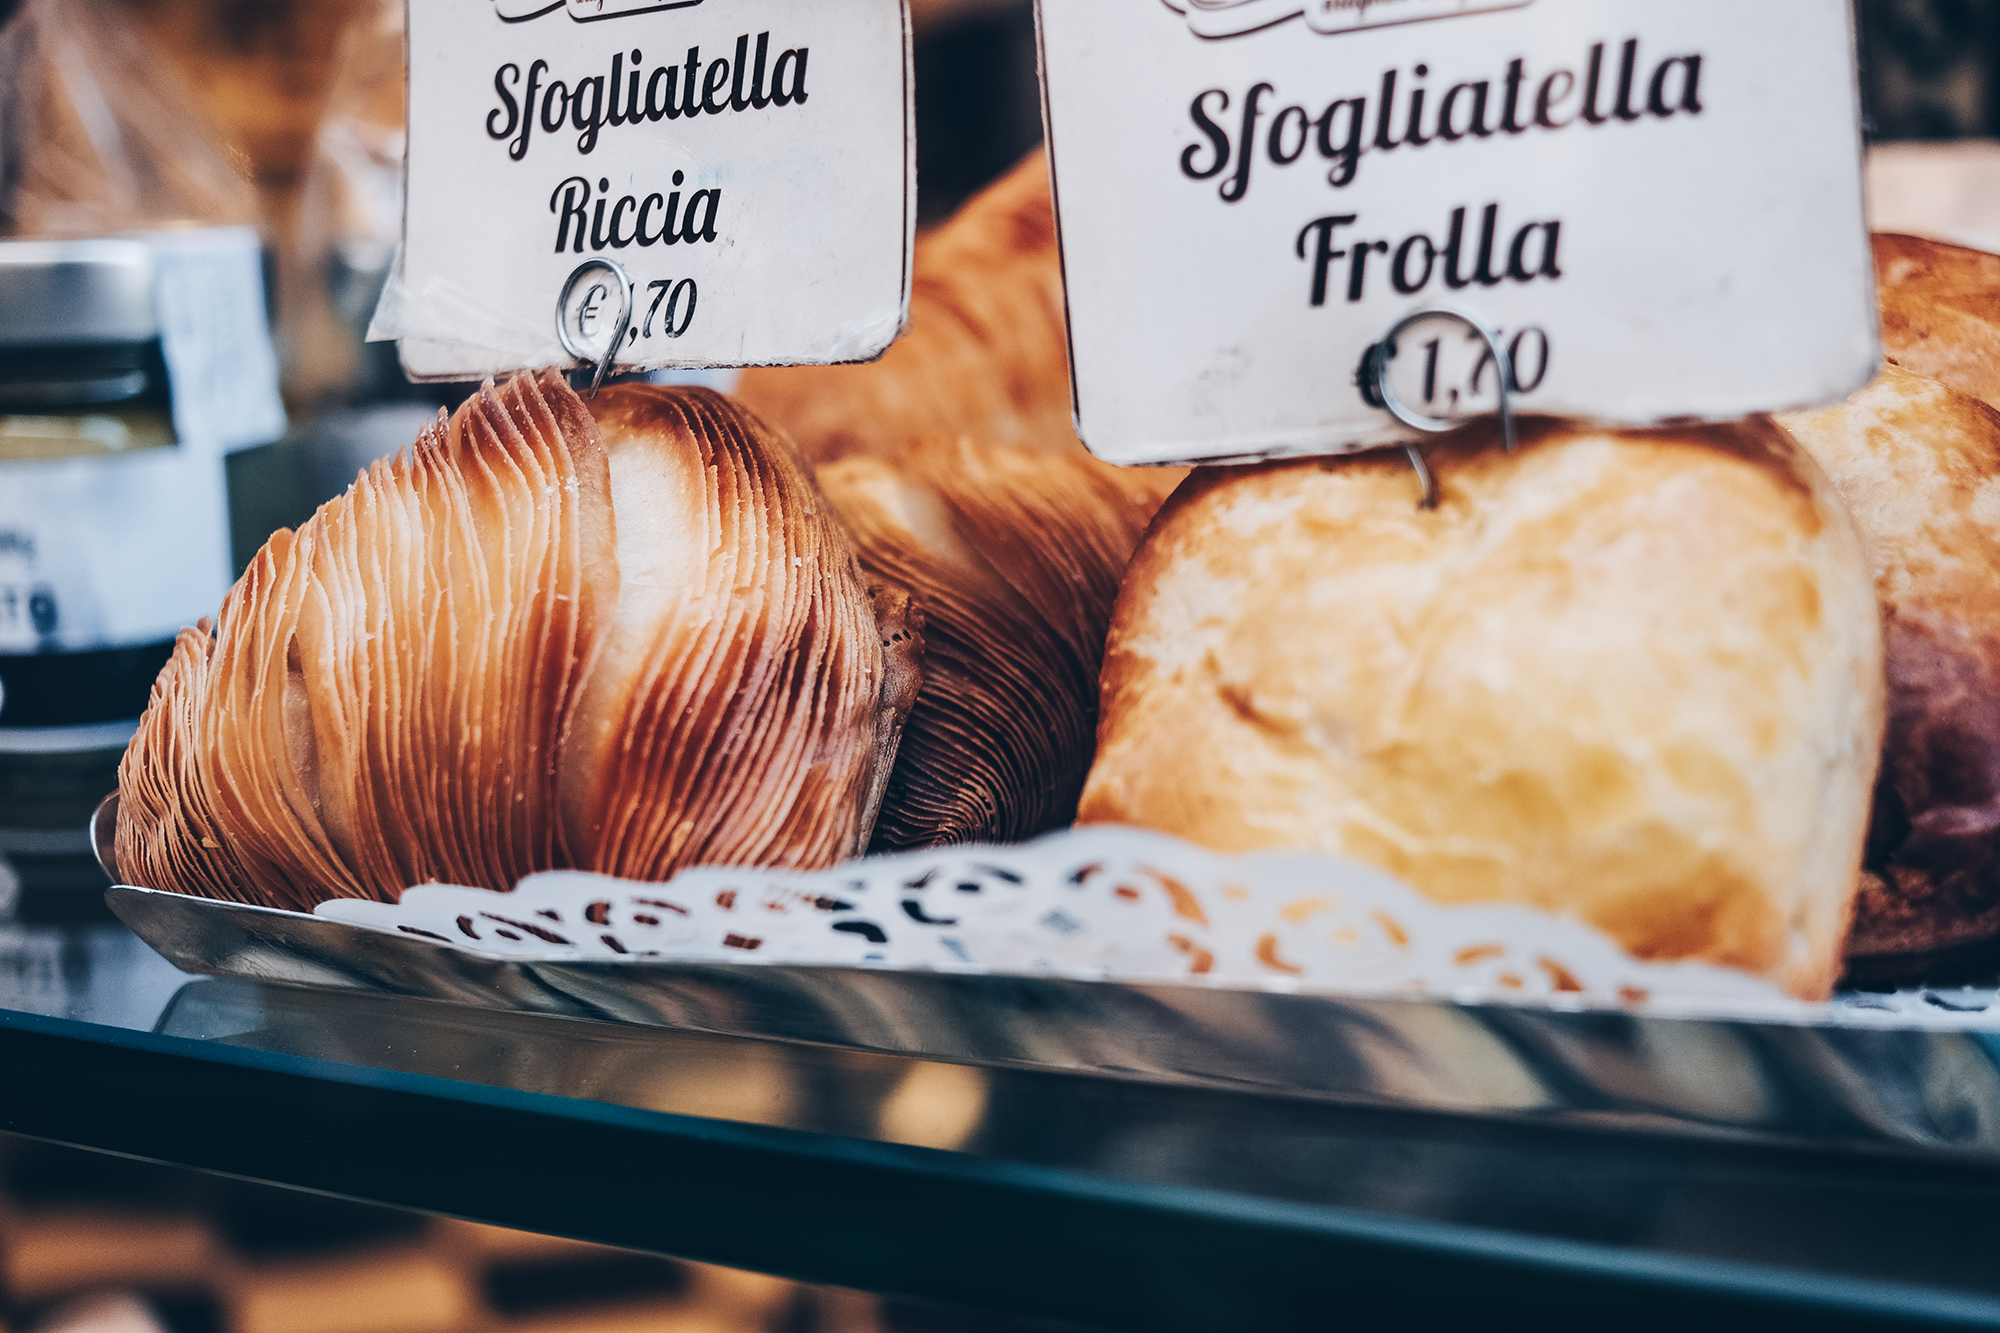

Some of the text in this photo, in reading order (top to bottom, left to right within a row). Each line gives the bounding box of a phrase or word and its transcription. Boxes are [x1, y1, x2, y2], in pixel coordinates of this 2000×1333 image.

[486, 31, 809, 161] Sfogliatella
[1180, 38, 1704, 204] Sfogliatella
[550, 170, 721, 253] Riccia
[1296, 203, 1562, 307] Frolla
[624, 278, 697, 347] ,70
